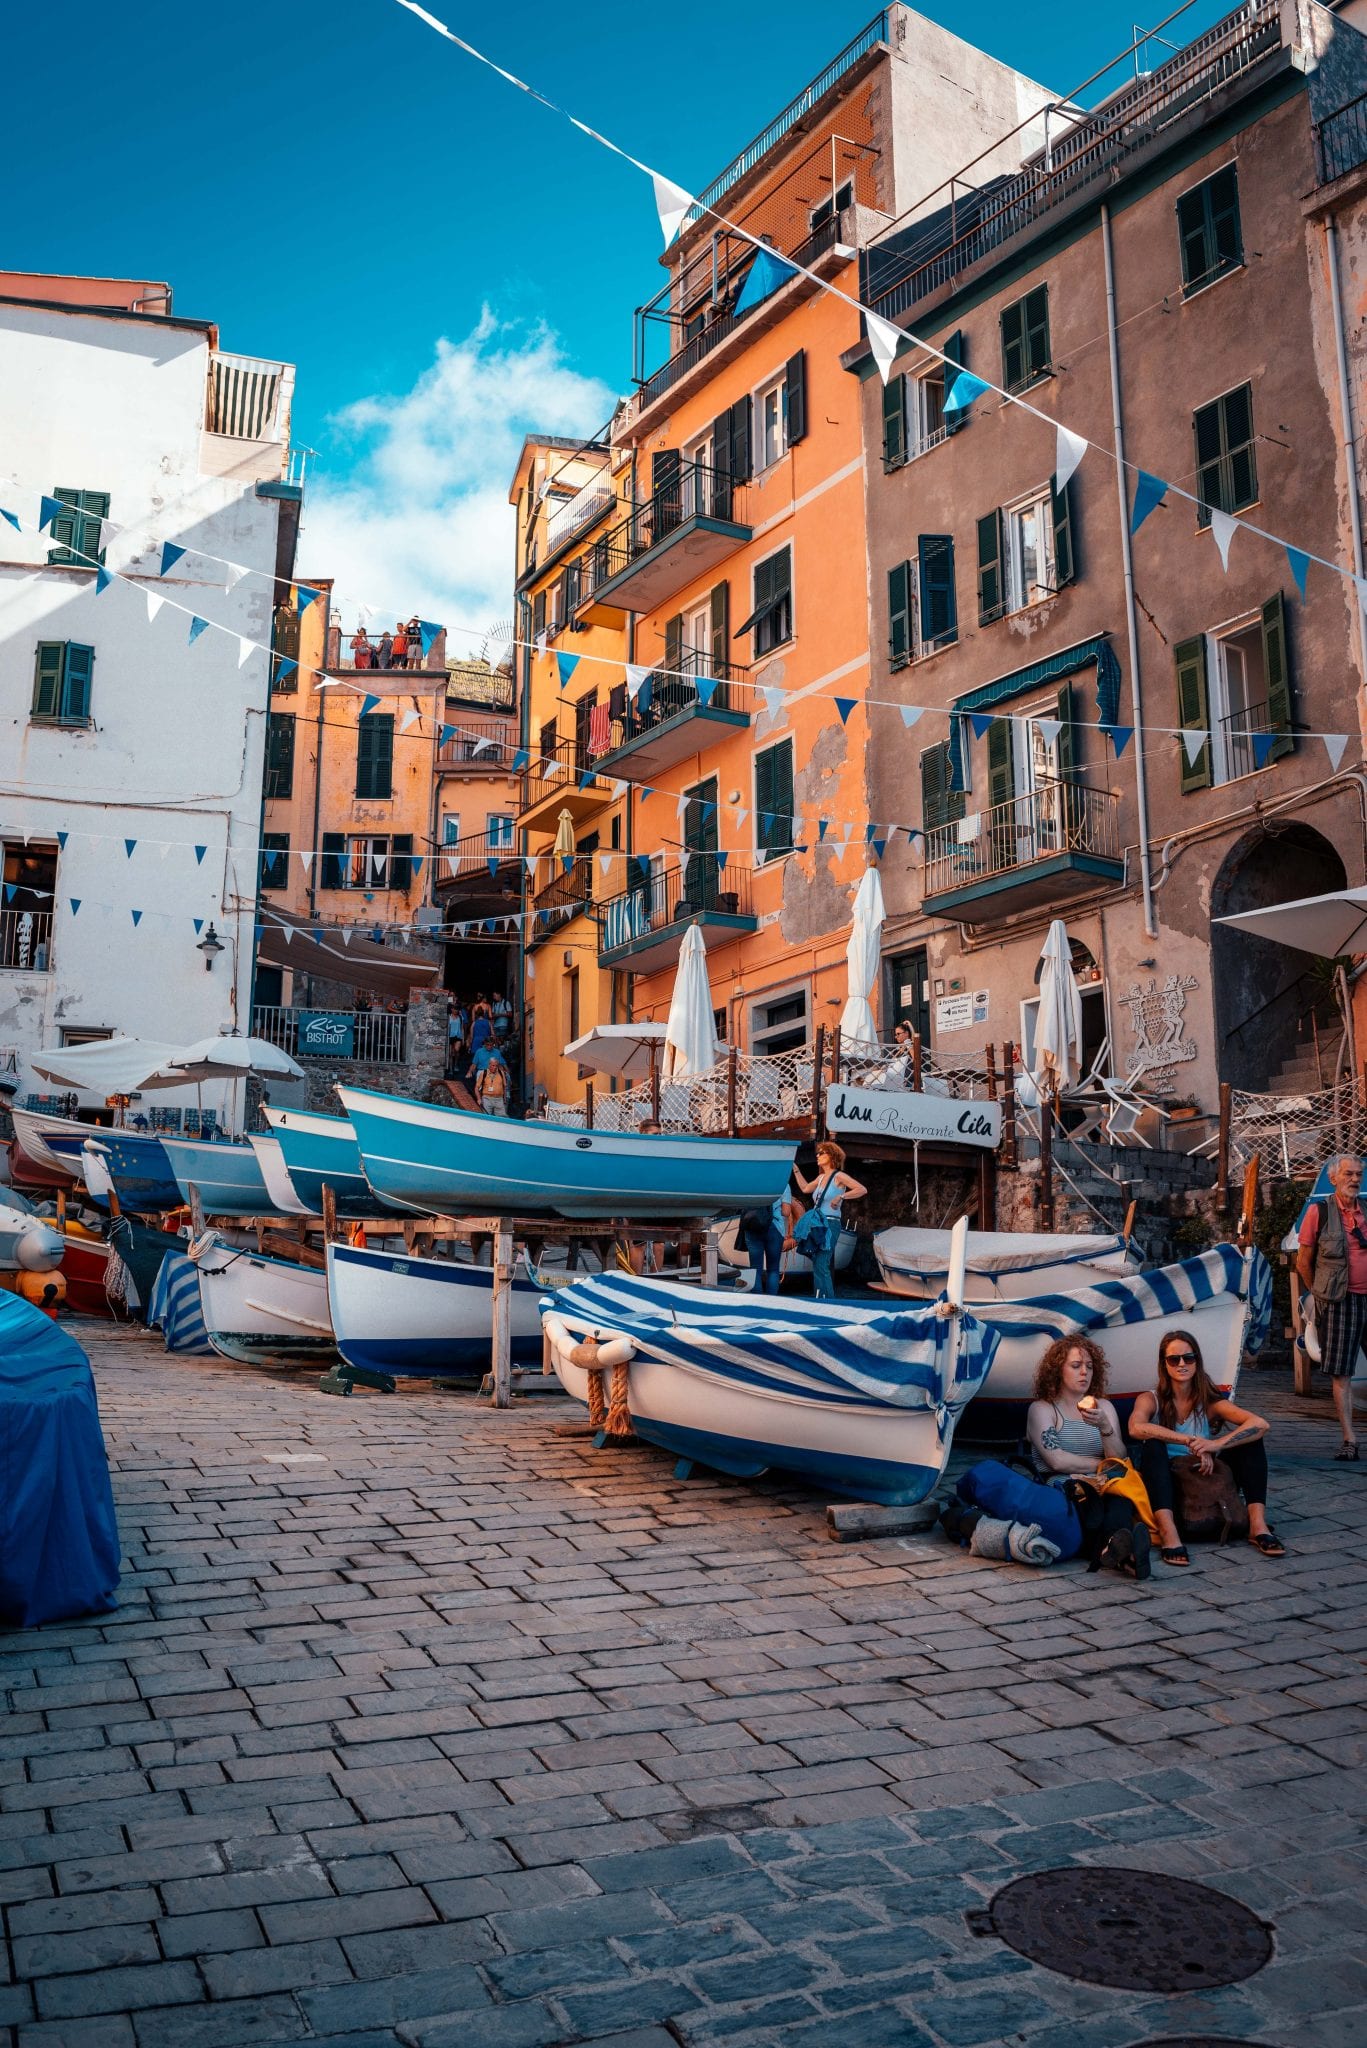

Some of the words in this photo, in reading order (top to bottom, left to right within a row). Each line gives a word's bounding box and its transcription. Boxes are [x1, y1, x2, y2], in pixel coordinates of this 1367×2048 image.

[305, 1017, 348, 1034] Rio
[306, 1032, 345, 1045] BISTROT
[280, 1114, 287, 1124] 4
[834, 1093, 873, 1122] dau
[876, 1107, 954, 1138] Ristorante
[957, 1110, 993, 1137] Cila
